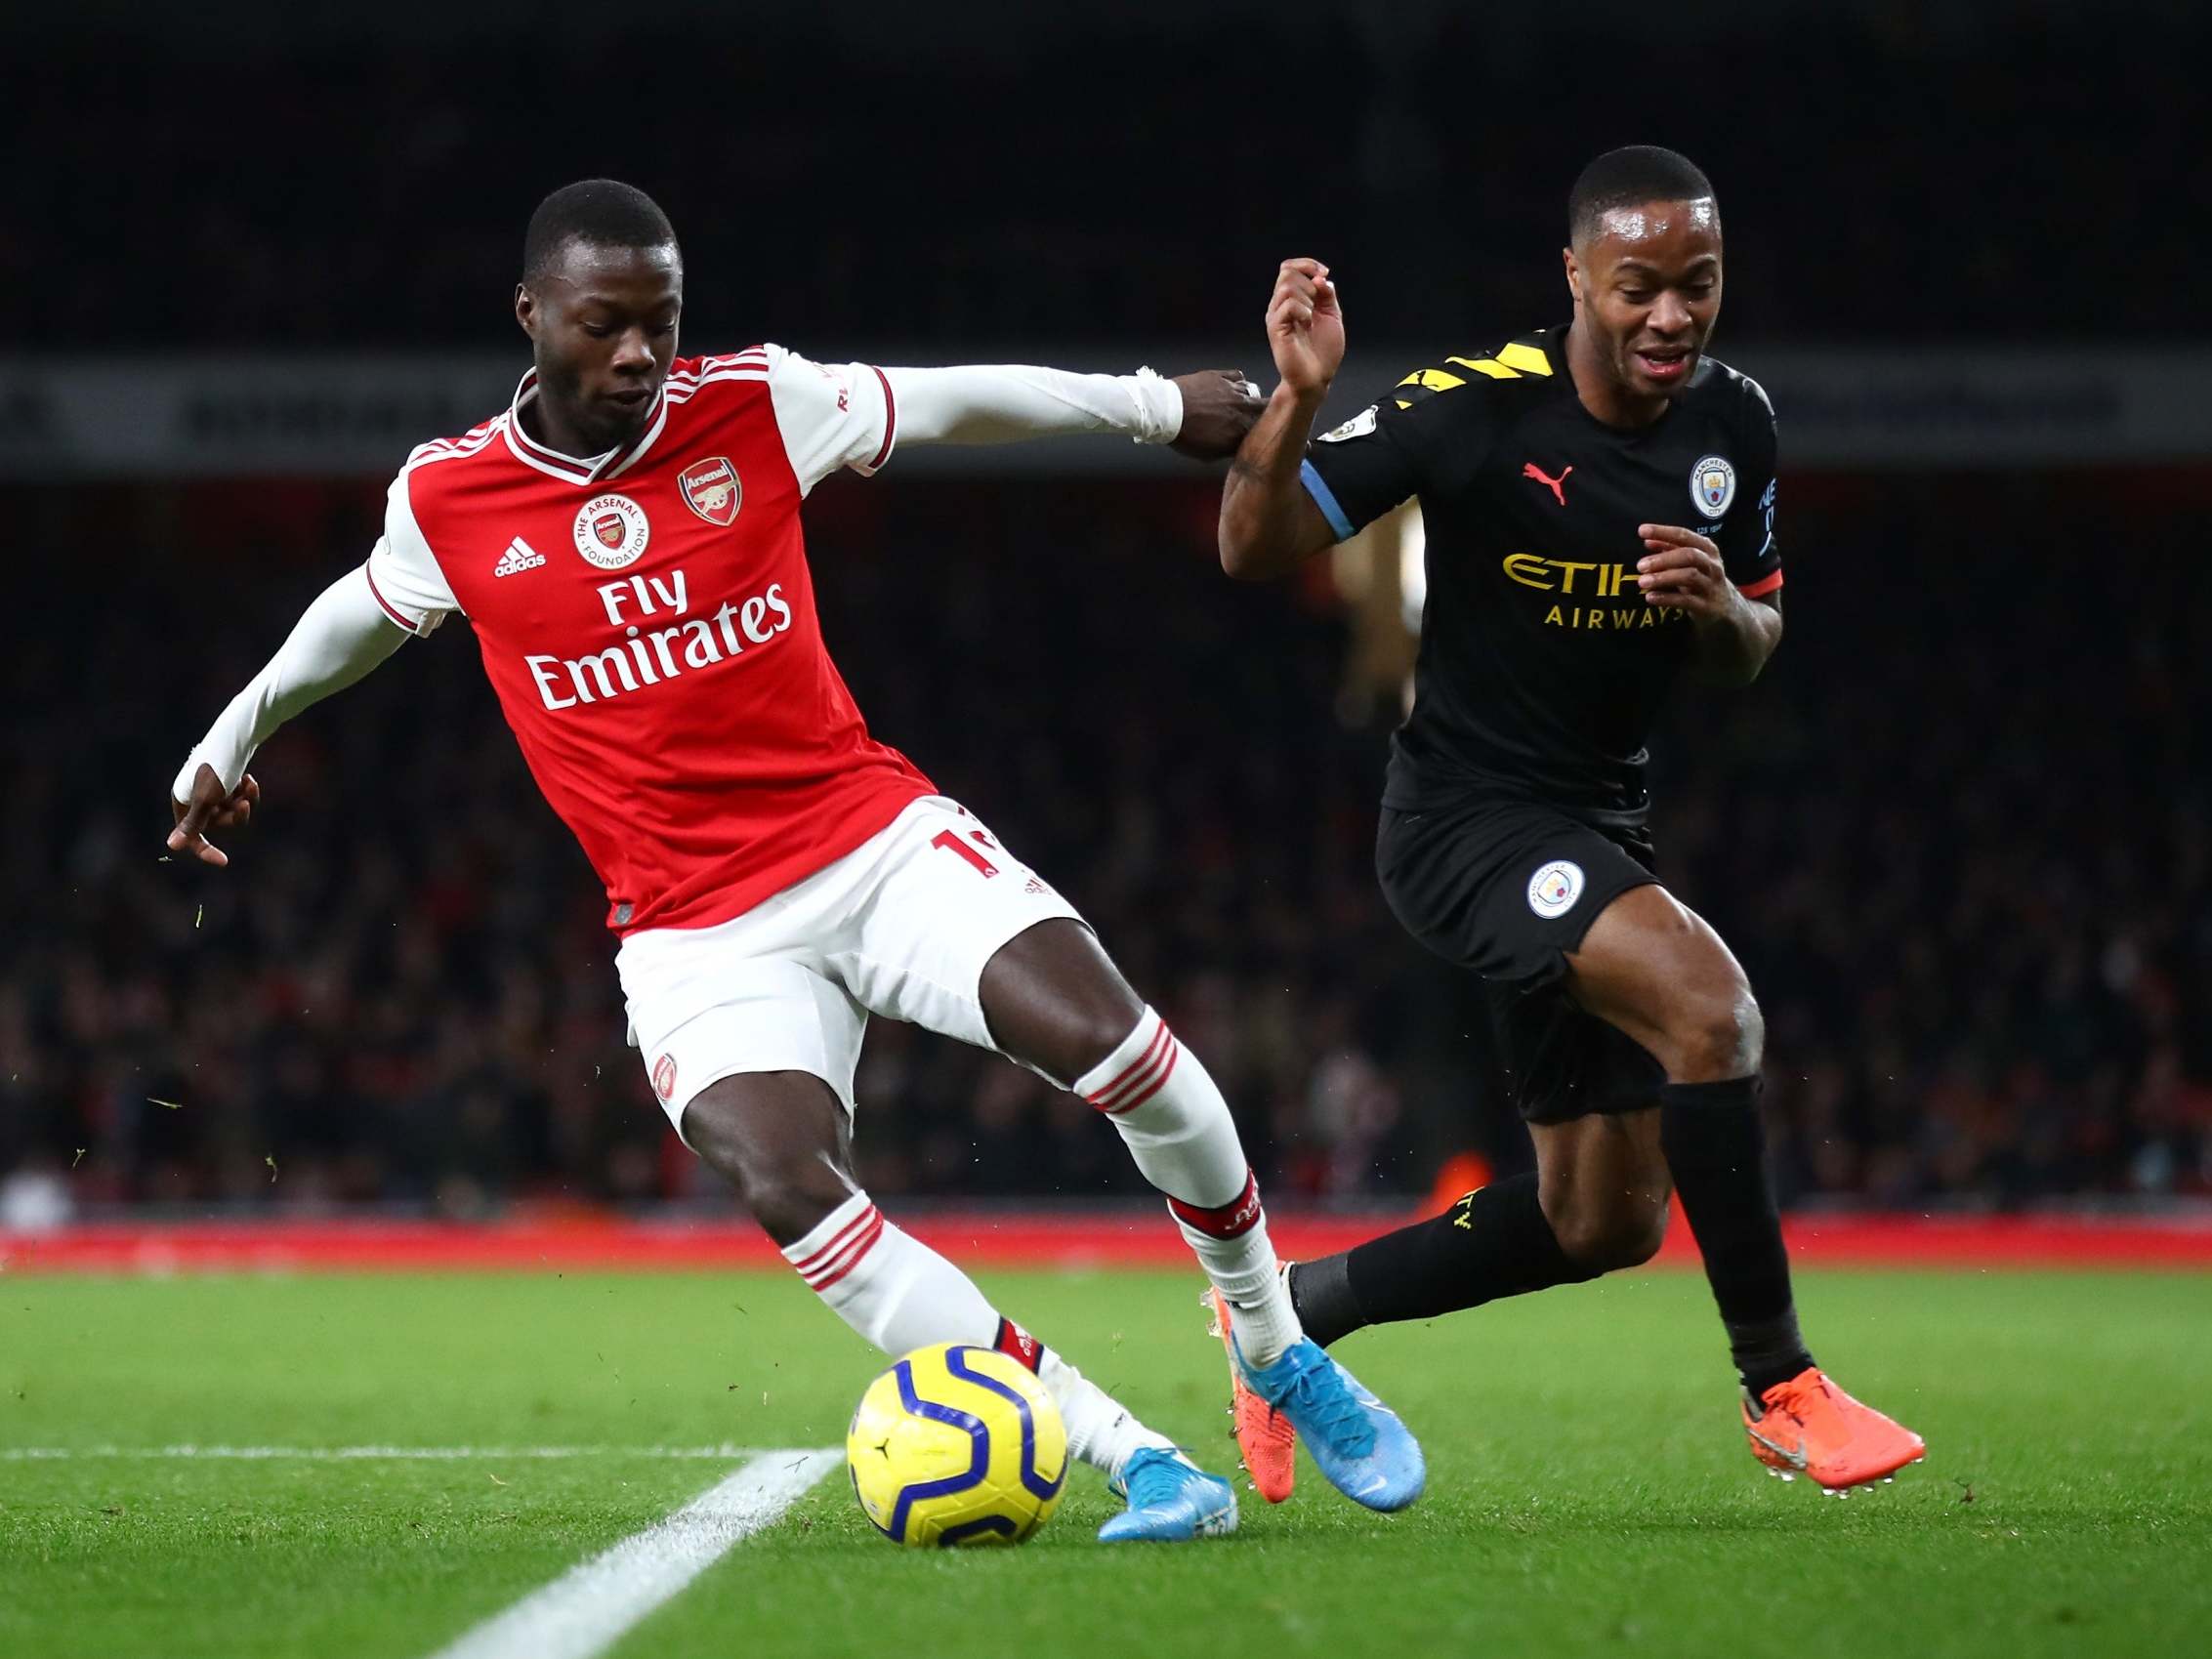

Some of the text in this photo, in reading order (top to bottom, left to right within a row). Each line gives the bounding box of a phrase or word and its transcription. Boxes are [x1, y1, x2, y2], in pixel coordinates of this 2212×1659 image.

[688, 466, 729, 488] Arsenal
[1694, 460, 1732, 480] MANCHESTER
[578, 499, 638, 538] THE ARSENAL
[583, 528, 645, 565] FOUNDATION
[494, 555, 546, 577] adidas
[1502, 553, 1649, 597] ETIH
[596, 569, 689, 626] Fly
[523, 584, 792, 711] Emirates
